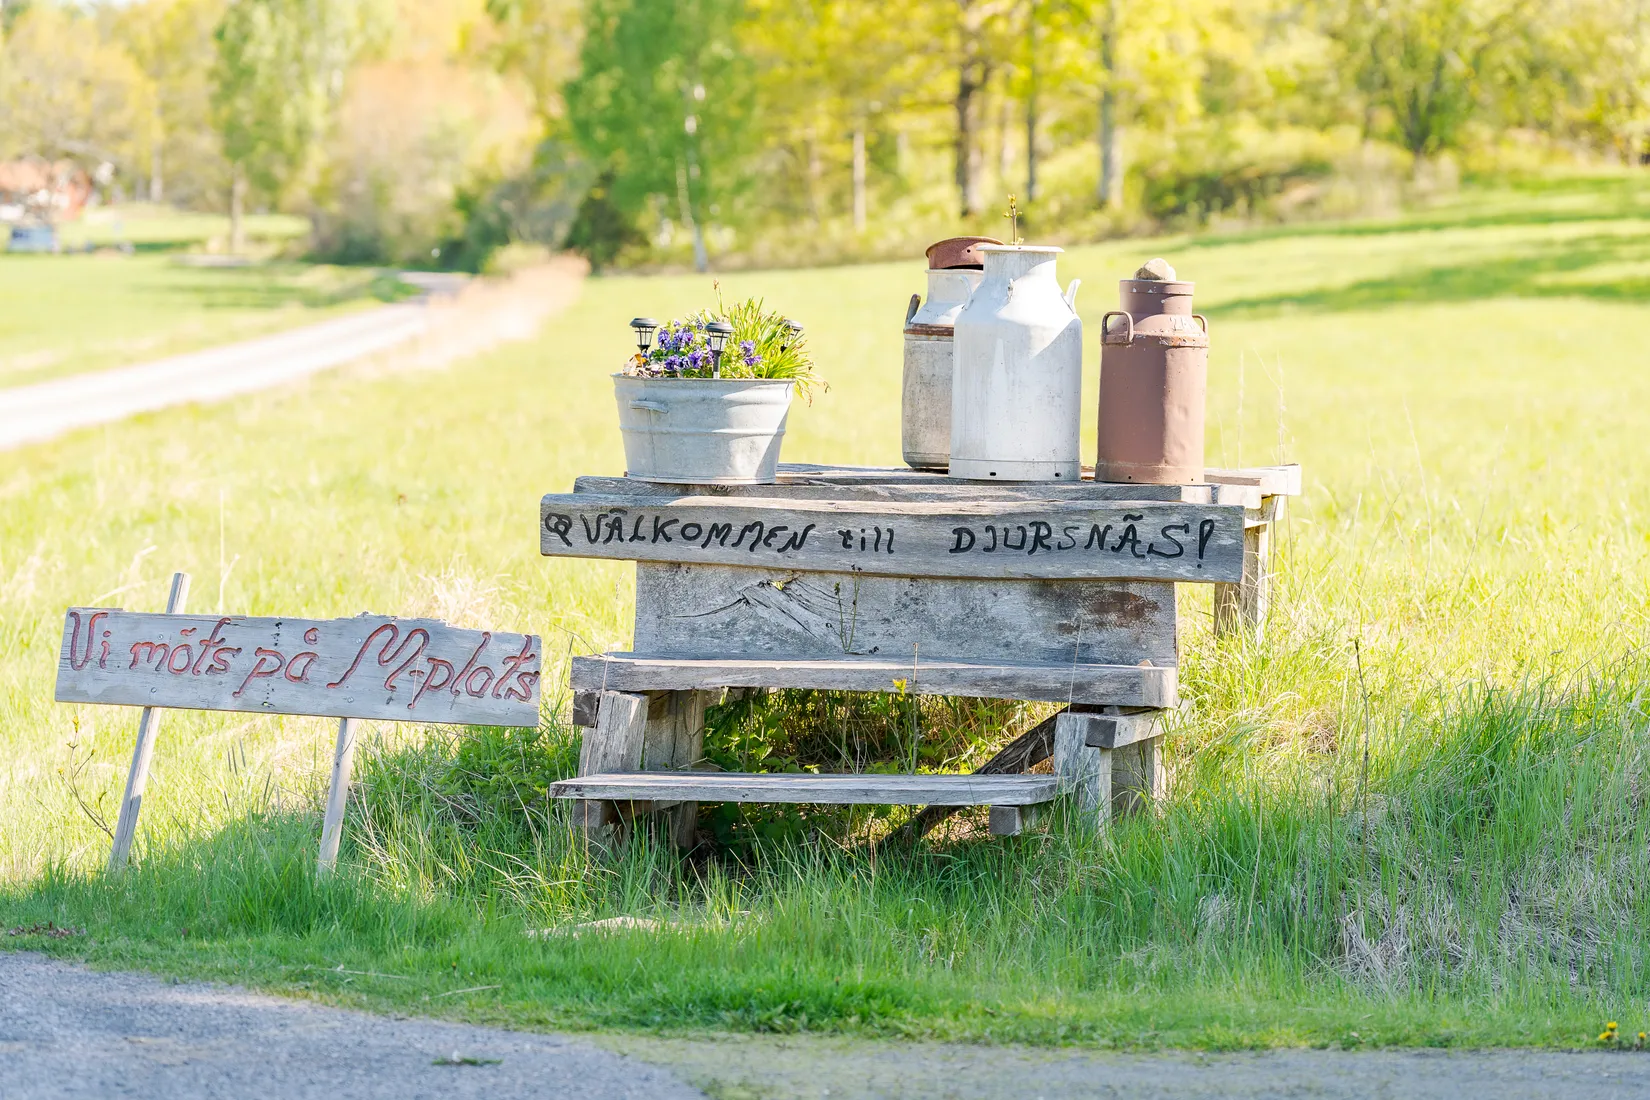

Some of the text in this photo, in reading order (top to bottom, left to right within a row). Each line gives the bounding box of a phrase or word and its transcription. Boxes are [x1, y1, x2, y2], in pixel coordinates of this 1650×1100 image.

[838, 526, 894, 554] till
[69, 611, 110, 671] Vi
[231, 627, 320, 698] på
